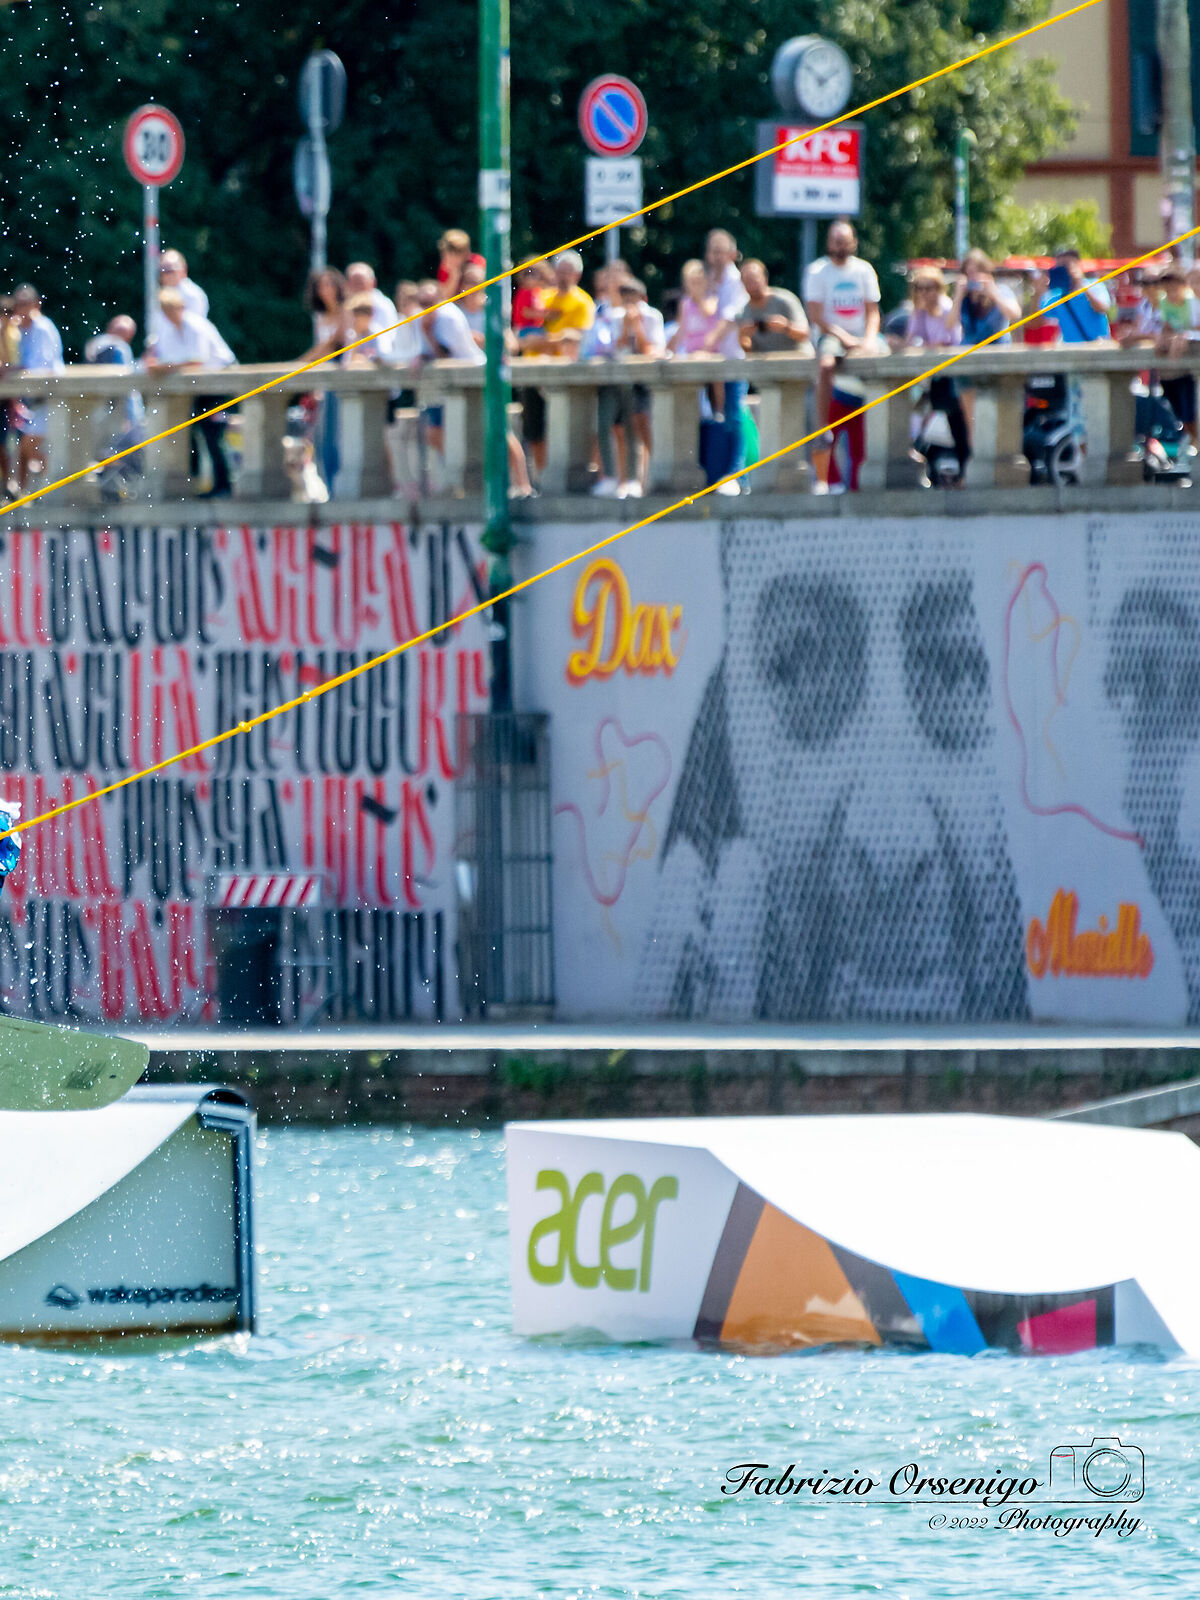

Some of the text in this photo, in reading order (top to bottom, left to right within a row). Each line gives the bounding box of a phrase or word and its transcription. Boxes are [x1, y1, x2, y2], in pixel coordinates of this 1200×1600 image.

[785, 129, 852, 163] KFC
[565, 558, 686, 688] Dax
[528, 1169, 679, 1293] acer
